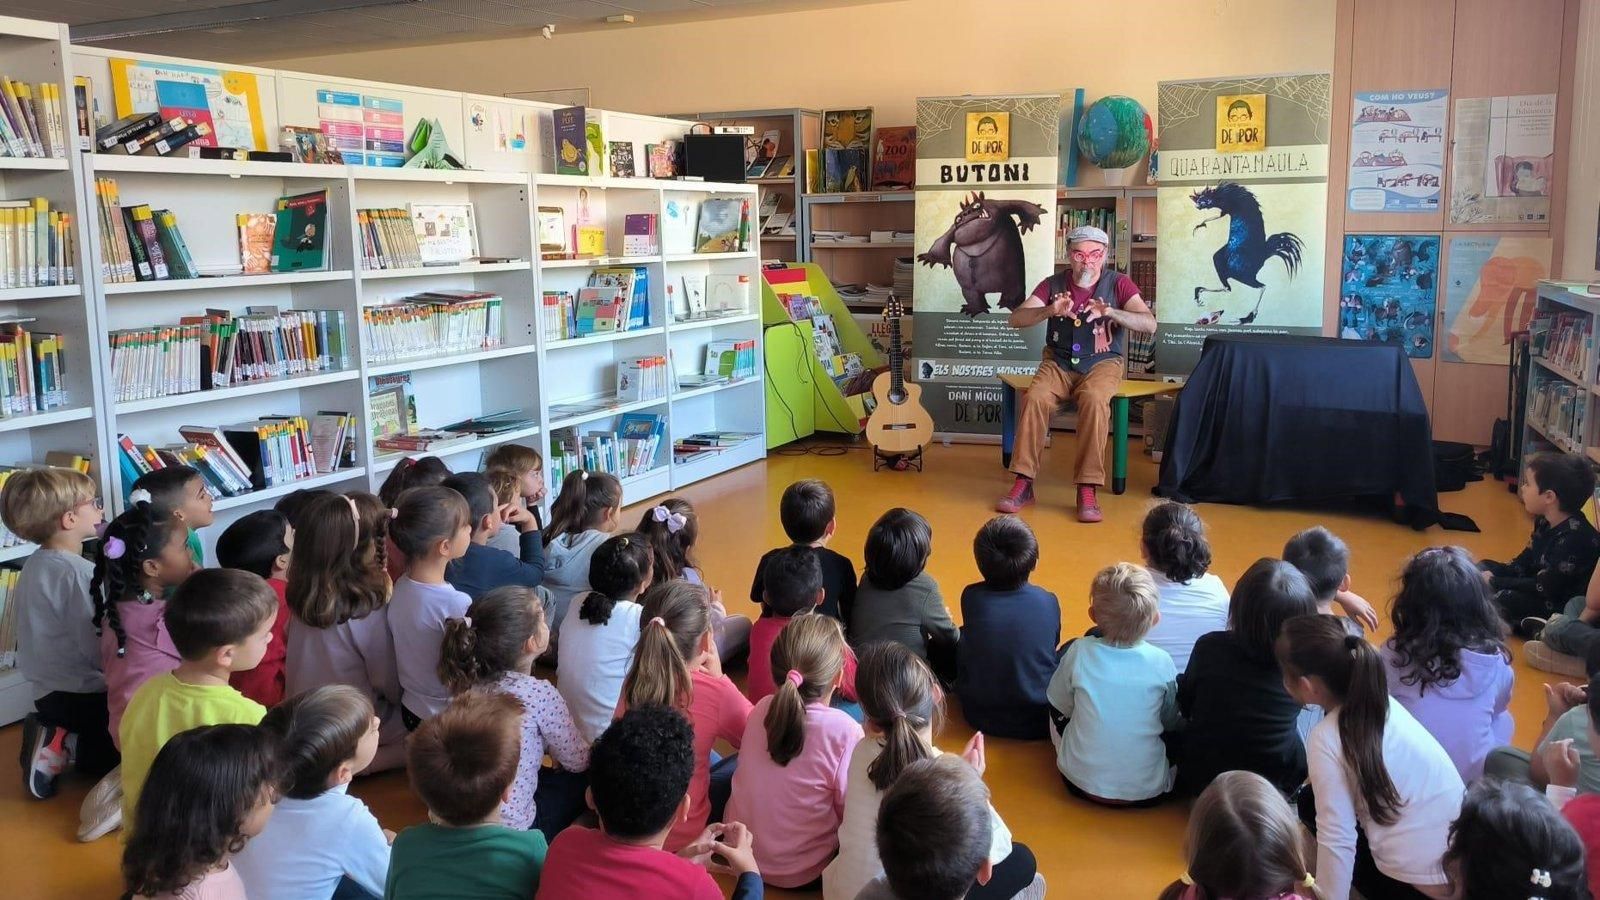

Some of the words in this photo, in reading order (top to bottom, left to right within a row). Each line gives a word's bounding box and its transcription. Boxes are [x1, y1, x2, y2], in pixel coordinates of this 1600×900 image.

[1221, 130, 1233, 144] DE
[1239, 128, 1259, 143] POR
[971, 141, 982, 154] DE
[940, 163, 1029, 183] BUTONI
[1170, 153, 1310, 176] QUARANTAMAULA
[933, 364, 949, 376] ELS
[951, 364, 994, 377] NOSTRES
[954, 403, 970, 422] DE
